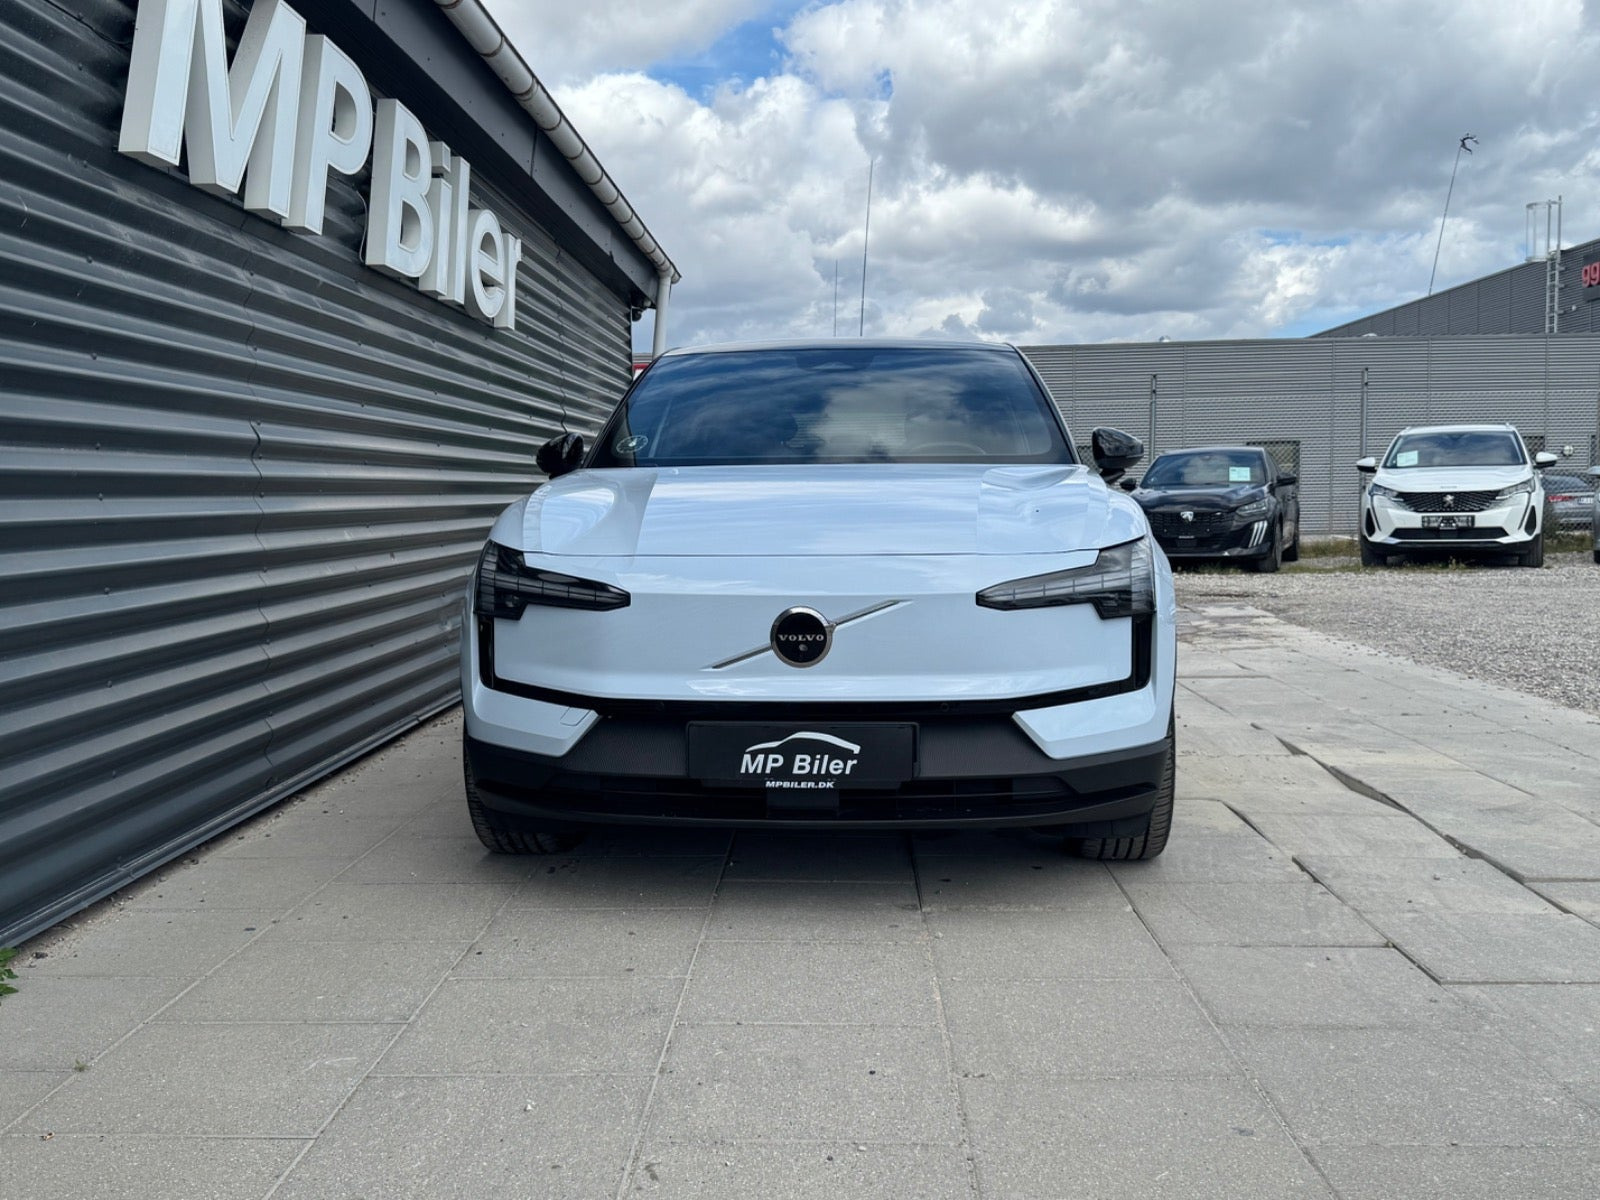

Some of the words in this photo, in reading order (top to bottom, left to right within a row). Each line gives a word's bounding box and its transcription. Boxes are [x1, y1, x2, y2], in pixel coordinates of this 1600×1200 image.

[118, 0, 373, 235] MP
[365, 99, 522, 329] Biler
[777, 633, 825, 642] VOLVO
[740, 753, 784, 774] MP
[792, 754, 858, 775] Biler
[765, 781, 835, 789] MPBILER.DK
